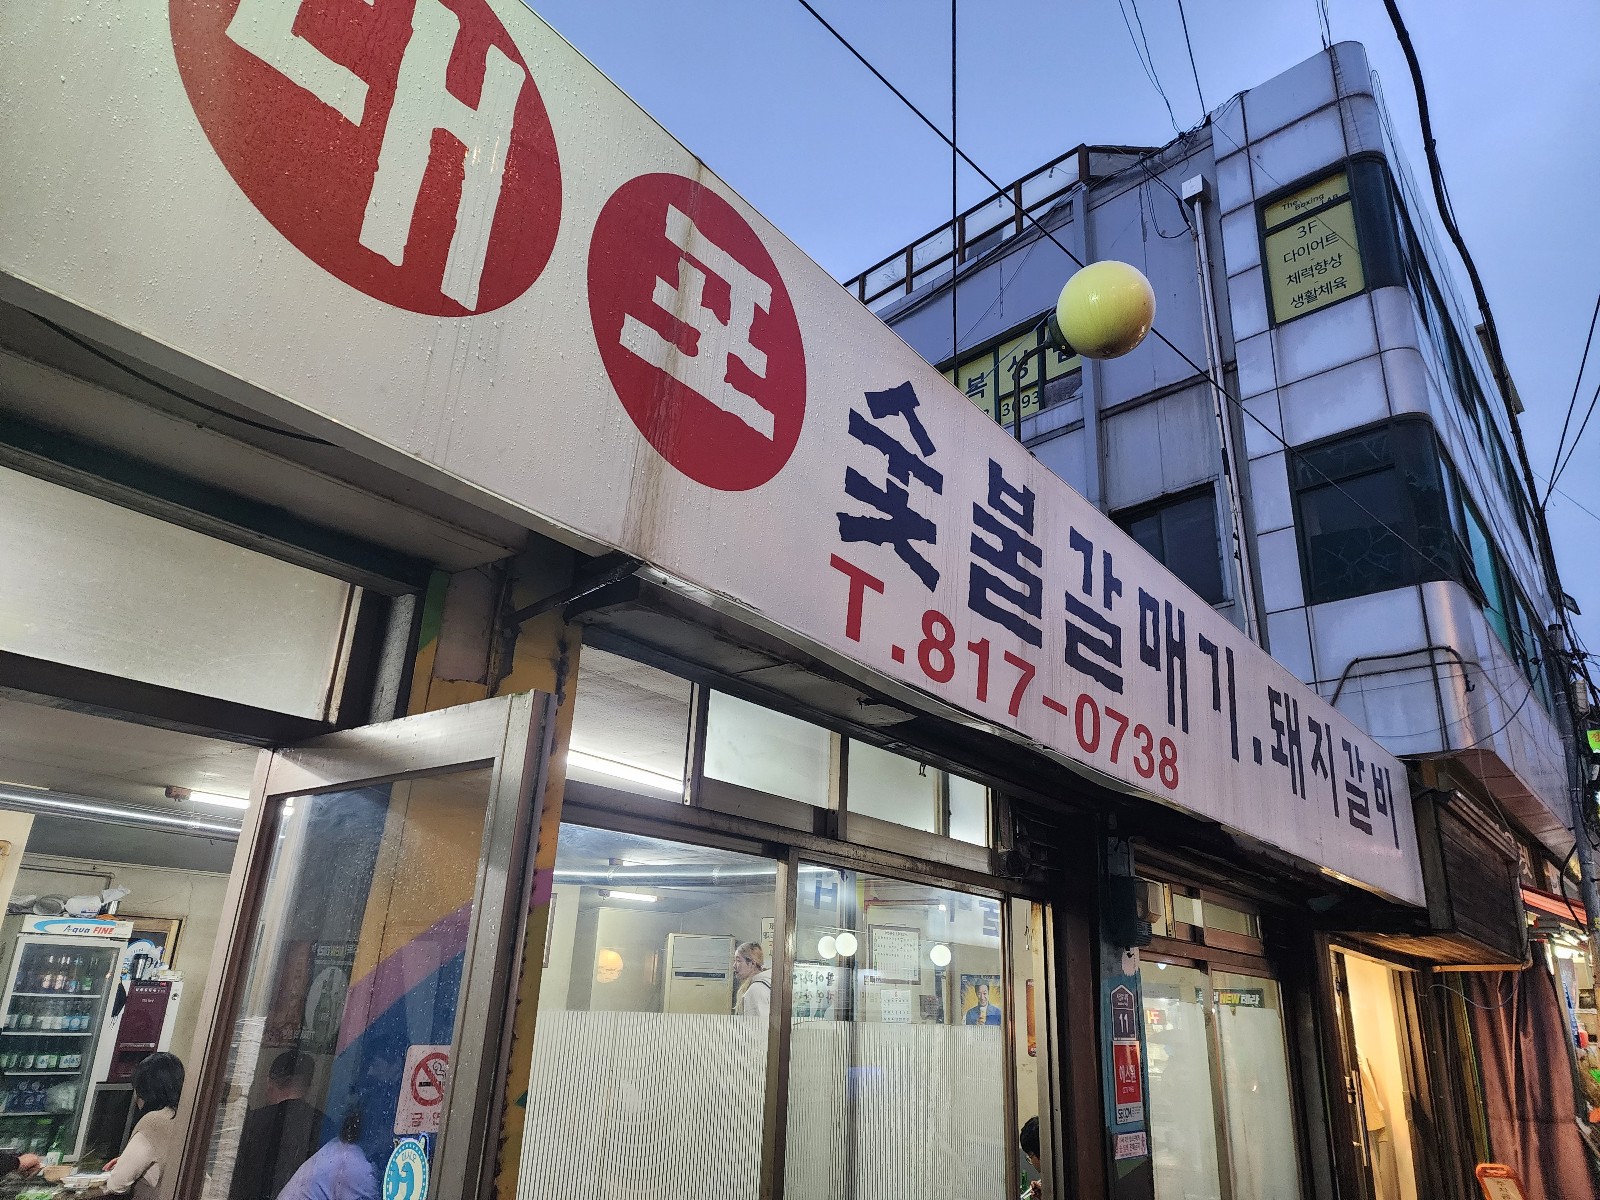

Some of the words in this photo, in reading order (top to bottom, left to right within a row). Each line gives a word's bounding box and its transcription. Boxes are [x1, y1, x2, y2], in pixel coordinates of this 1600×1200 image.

[1281, 200, 1298, 211] The
[1295, 193, 1325, 211] Boxing
[1297, 220, 1318, 239] 3F
[1283, 232, 1340, 263] 다이어트
[1286, 252, 1343, 286] 체력향상
[1290, 276, 1348, 309] 생활체육
[830, 553, 1179, 790] T.817-0738
[92, 926, 115, 935] FINE
[1220, 992, 1240, 1004] NEW
[1241, 993, 1260, 1005] 테라
[1119, 1013, 1129, 1033] 11
